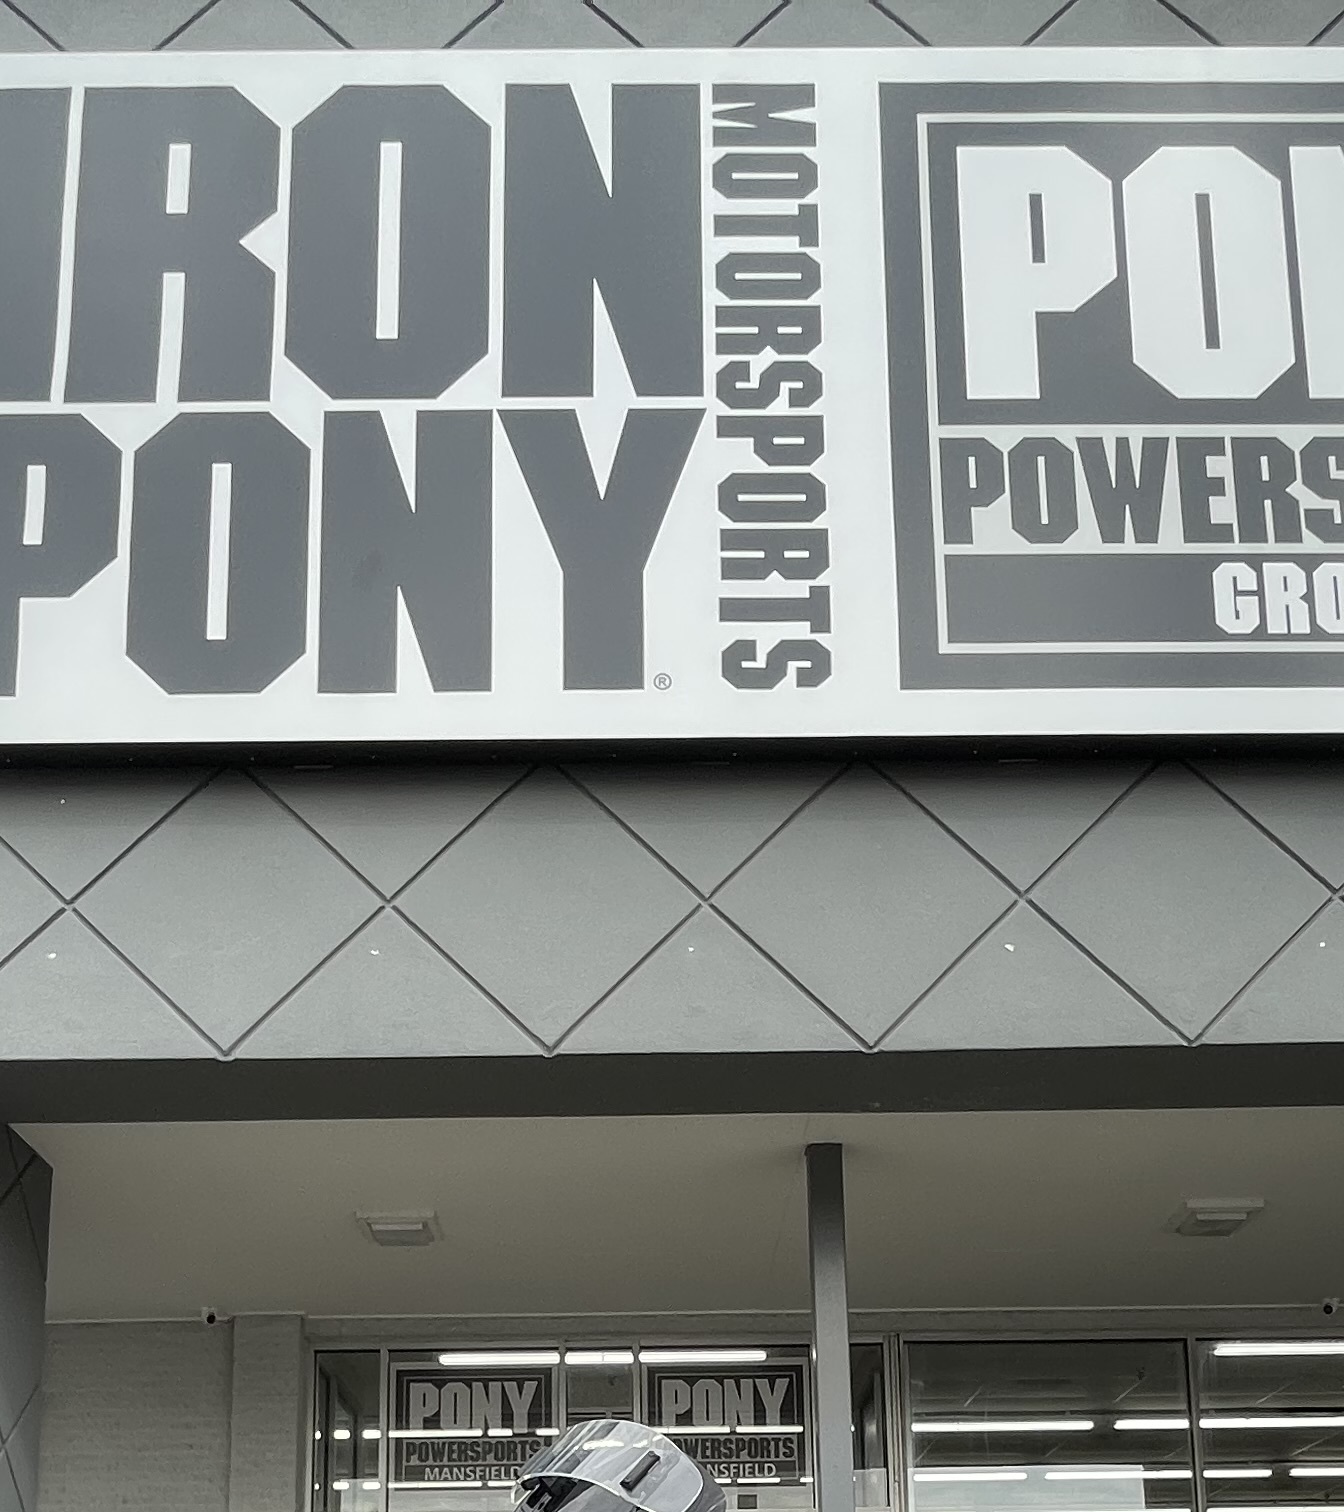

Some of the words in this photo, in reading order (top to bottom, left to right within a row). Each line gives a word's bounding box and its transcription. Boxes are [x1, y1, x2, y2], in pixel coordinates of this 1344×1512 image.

[711, 83, 834, 690] MOTORSPORTS
[409, 1381, 538, 1434] PONY
[661, 1378, 790, 1429] PONY
[406, 1439, 542, 1463] POWERSPORTS
[672, 1437, 795, 1460] WERSPORTS
[424, 1466, 520, 1481] MANSFIELD
[706, 1463, 777, 1478] NSFIELD
